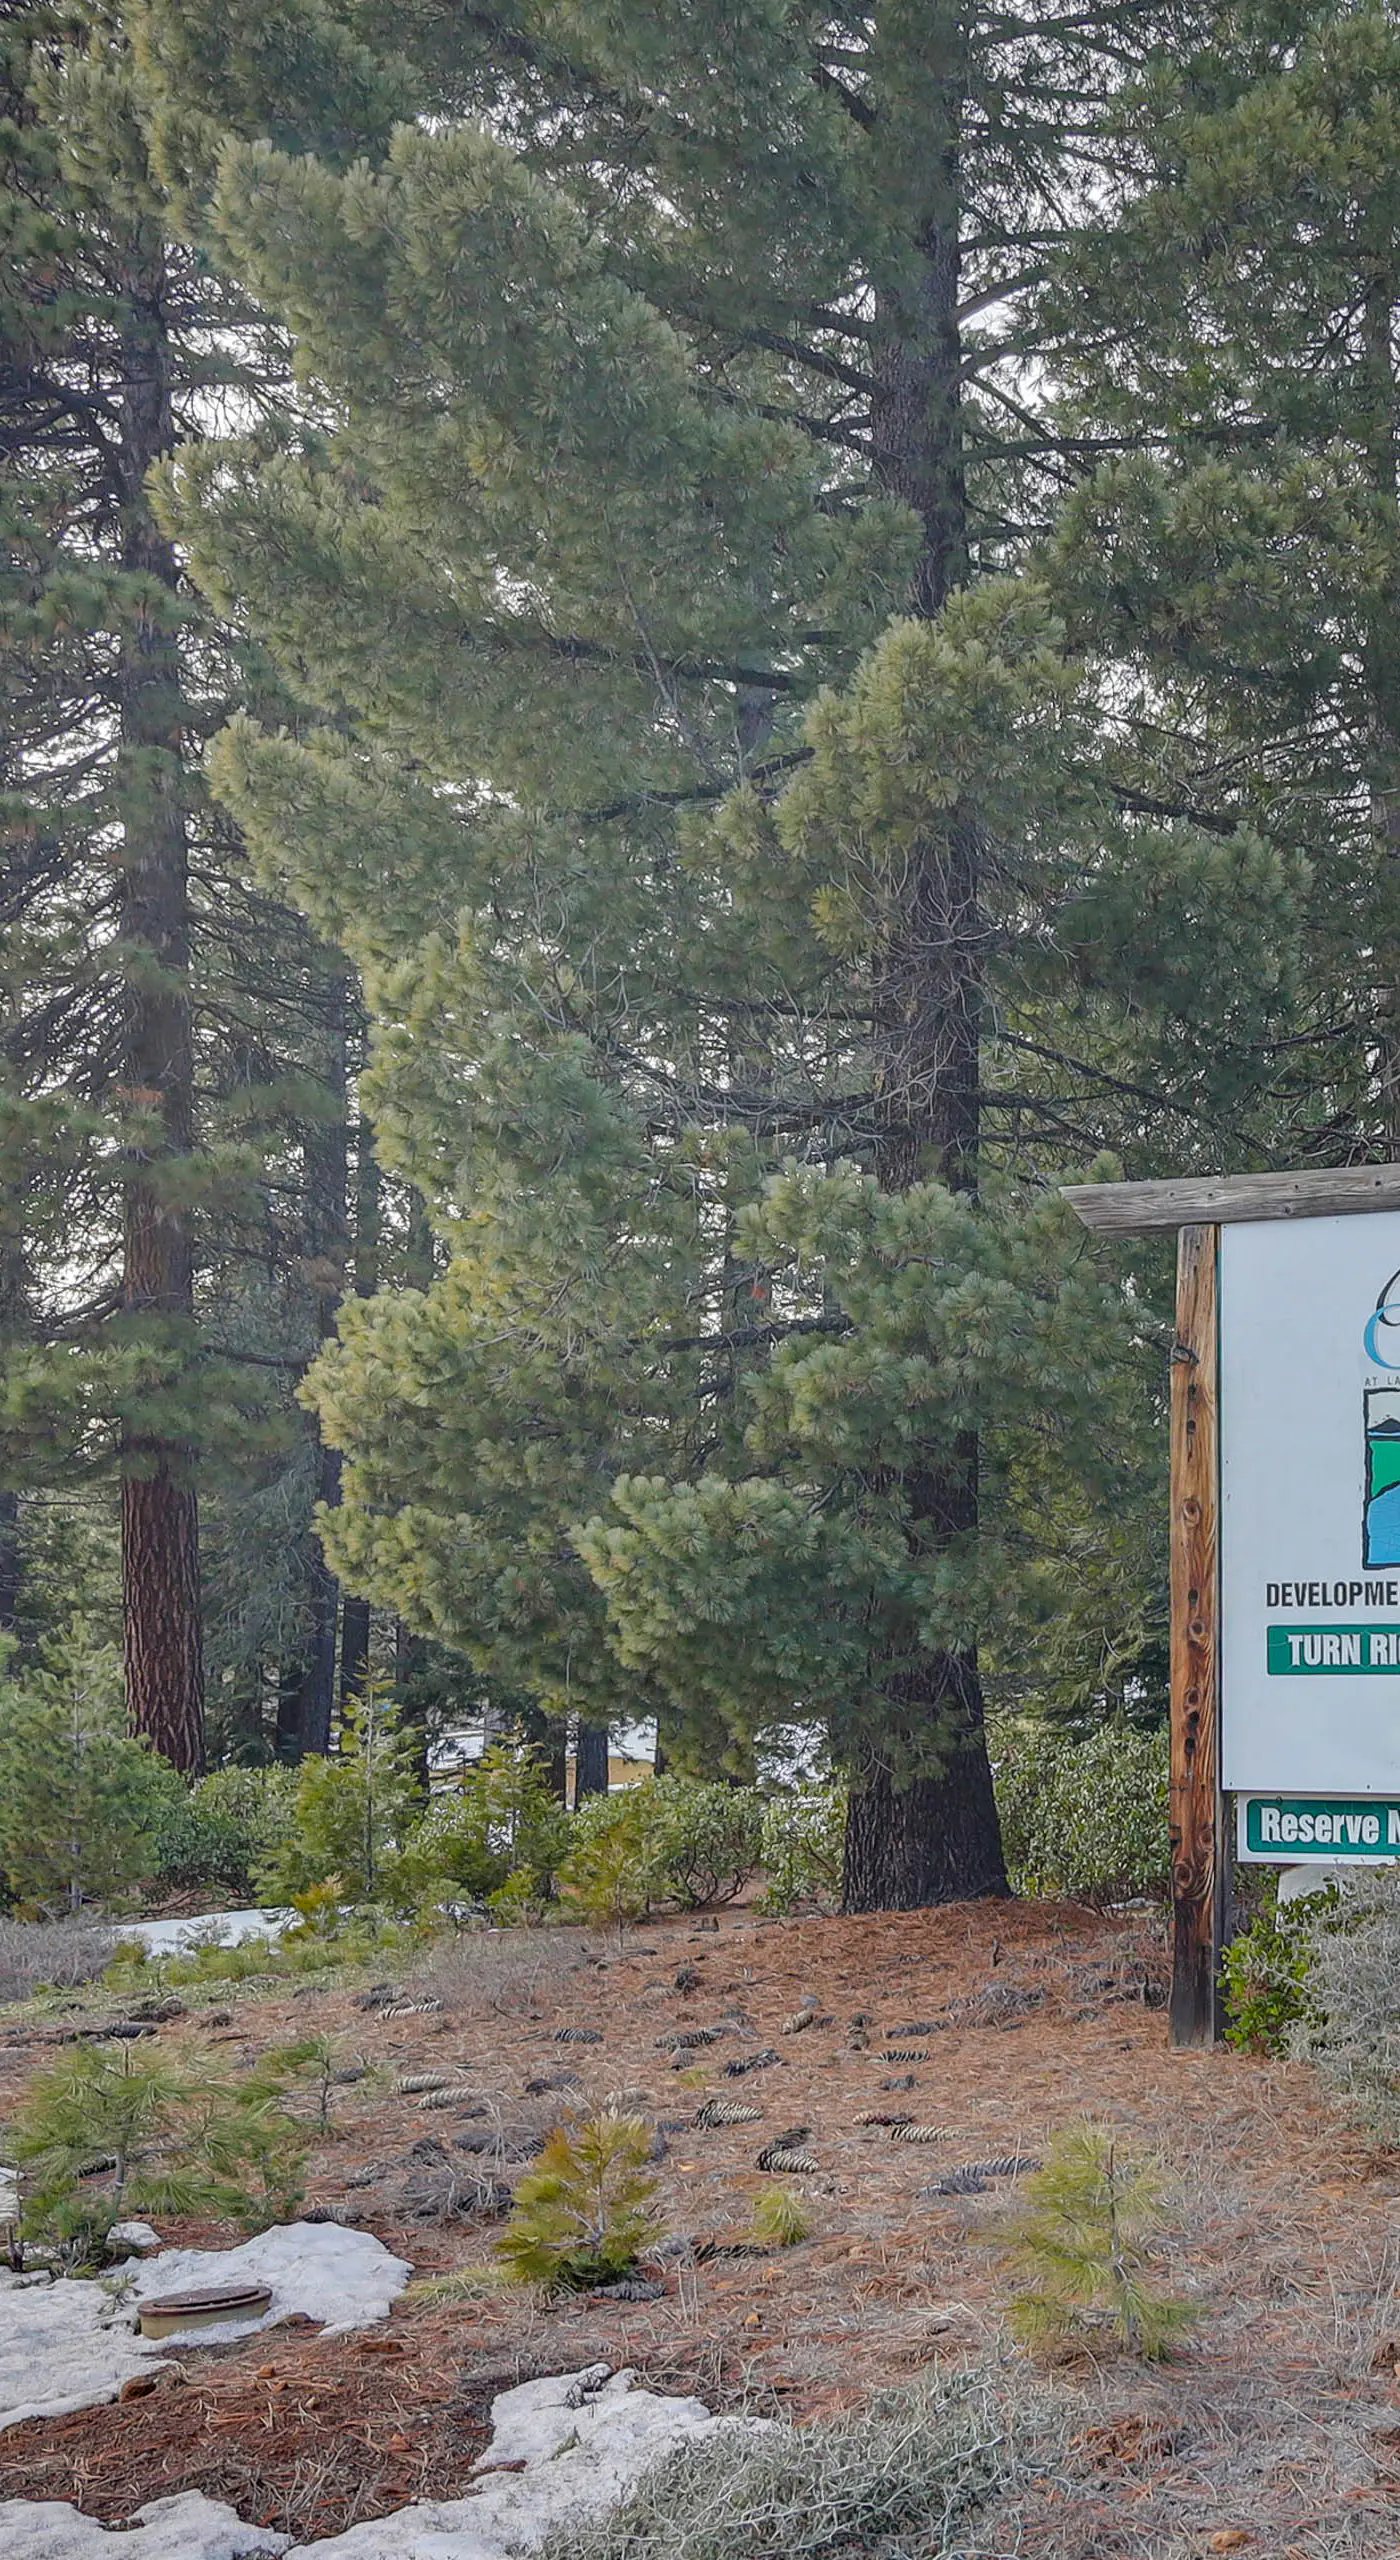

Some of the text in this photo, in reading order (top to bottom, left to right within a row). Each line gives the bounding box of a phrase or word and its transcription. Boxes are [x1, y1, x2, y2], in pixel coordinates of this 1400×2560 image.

[1266, 1581, 1398, 1607] DEVELOPME
[1288, 1633, 1400, 1667] TURN RI
[1260, 1807, 1380, 1845] Reserve
